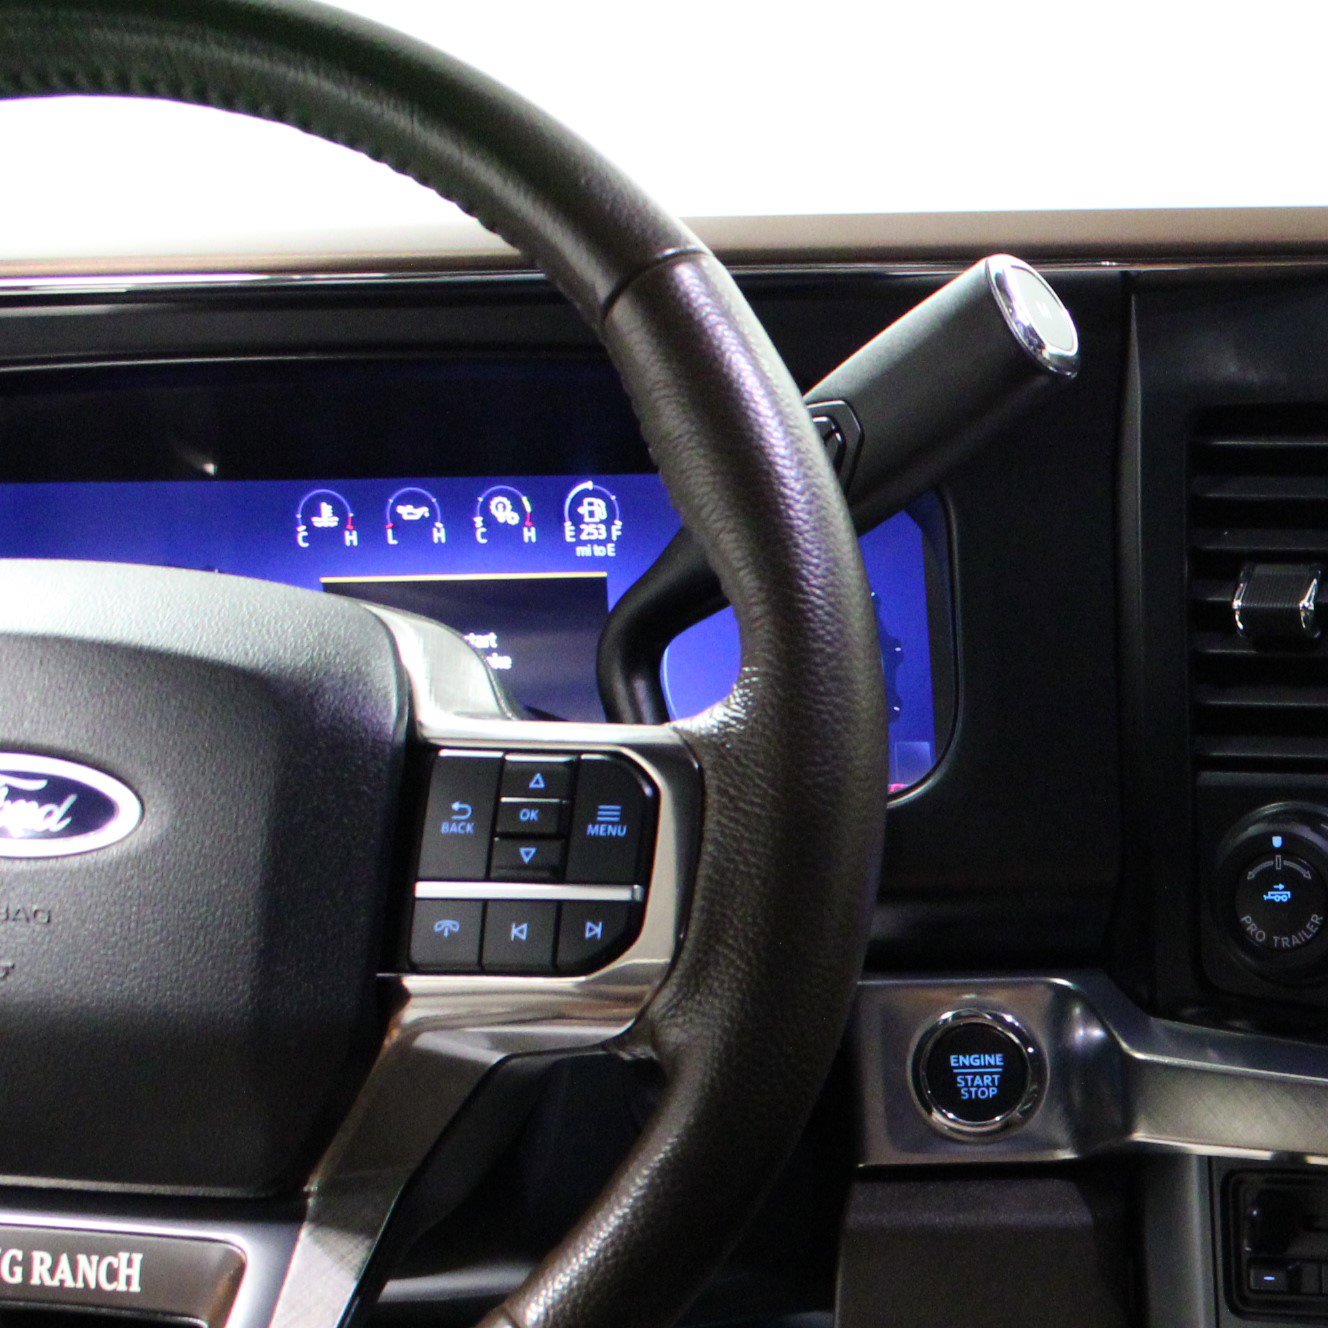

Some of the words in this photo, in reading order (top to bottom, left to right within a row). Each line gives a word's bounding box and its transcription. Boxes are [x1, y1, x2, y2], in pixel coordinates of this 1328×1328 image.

[345, 530, 358, 547] H
[387, 528, 398, 544] L
[433, 527, 445, 544] H
[476, 527, 488, 543] C
[523, 527, 536, 543] H
[565, 526, 576, 542] E
[579, 524, 607, 540] 253
[611, 525, 622, 541] F
[576, 544, 592, 557] mi
[607, 543, 616, 557] E
[519, 808, 540, 822] OK
[441, 822, 475, 834] BACK
[586, 824, 628, 836] MENU
[1241, 914, 1266, 942] PRO
[1272, 912, 1324, 949] TRAILER
[950, 1053, 1004, 1067] ENGINE
[956, 1074, 1001, 1087] START
[960, 1087, 998, 1100] STOP
[30, 1250, 144, 1293] RANCH
